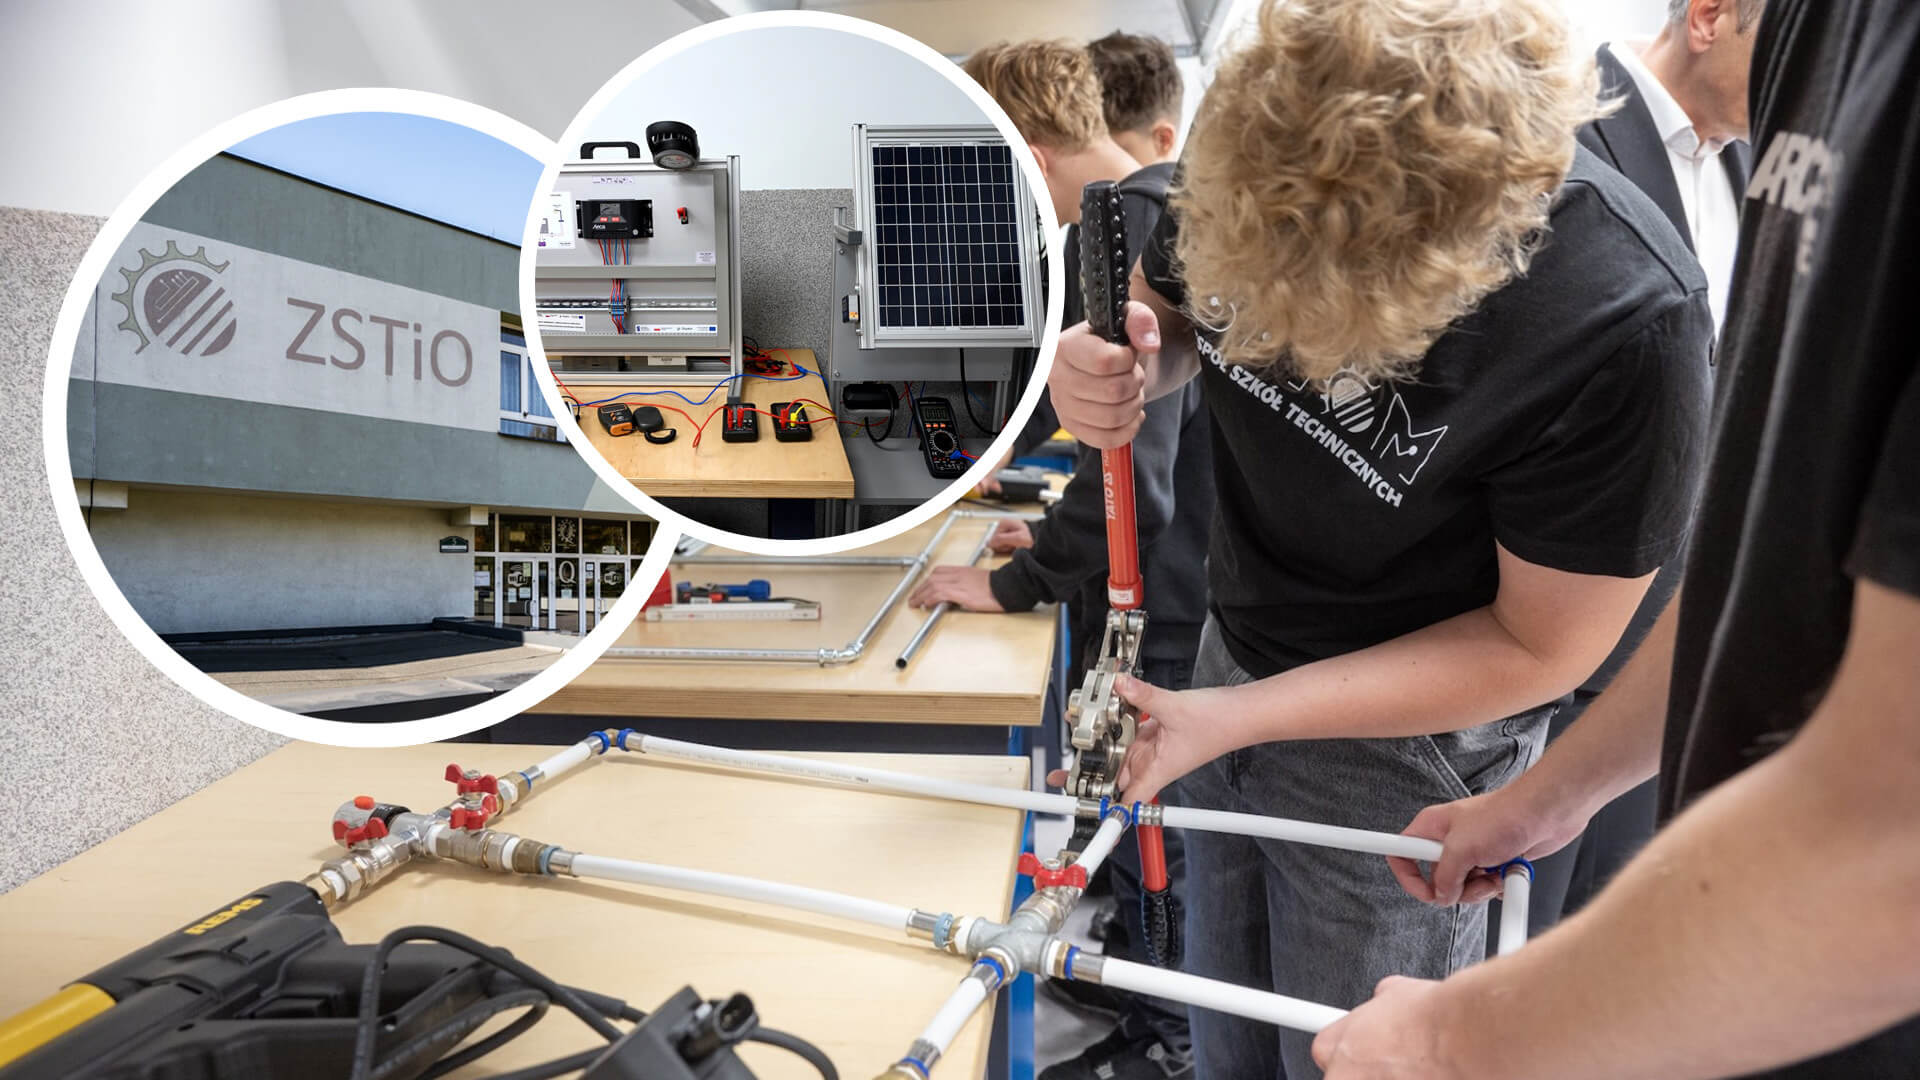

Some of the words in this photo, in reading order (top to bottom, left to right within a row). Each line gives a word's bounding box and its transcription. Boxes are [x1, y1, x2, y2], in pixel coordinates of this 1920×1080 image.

[286, 297, 473, 387] ZSTiO
[1229, 365, 1283, 412] SZKÓŁ
[1285, 403, 1403, 507] TECHNICZNYCH
[184, 898, 263, 936] REMS
